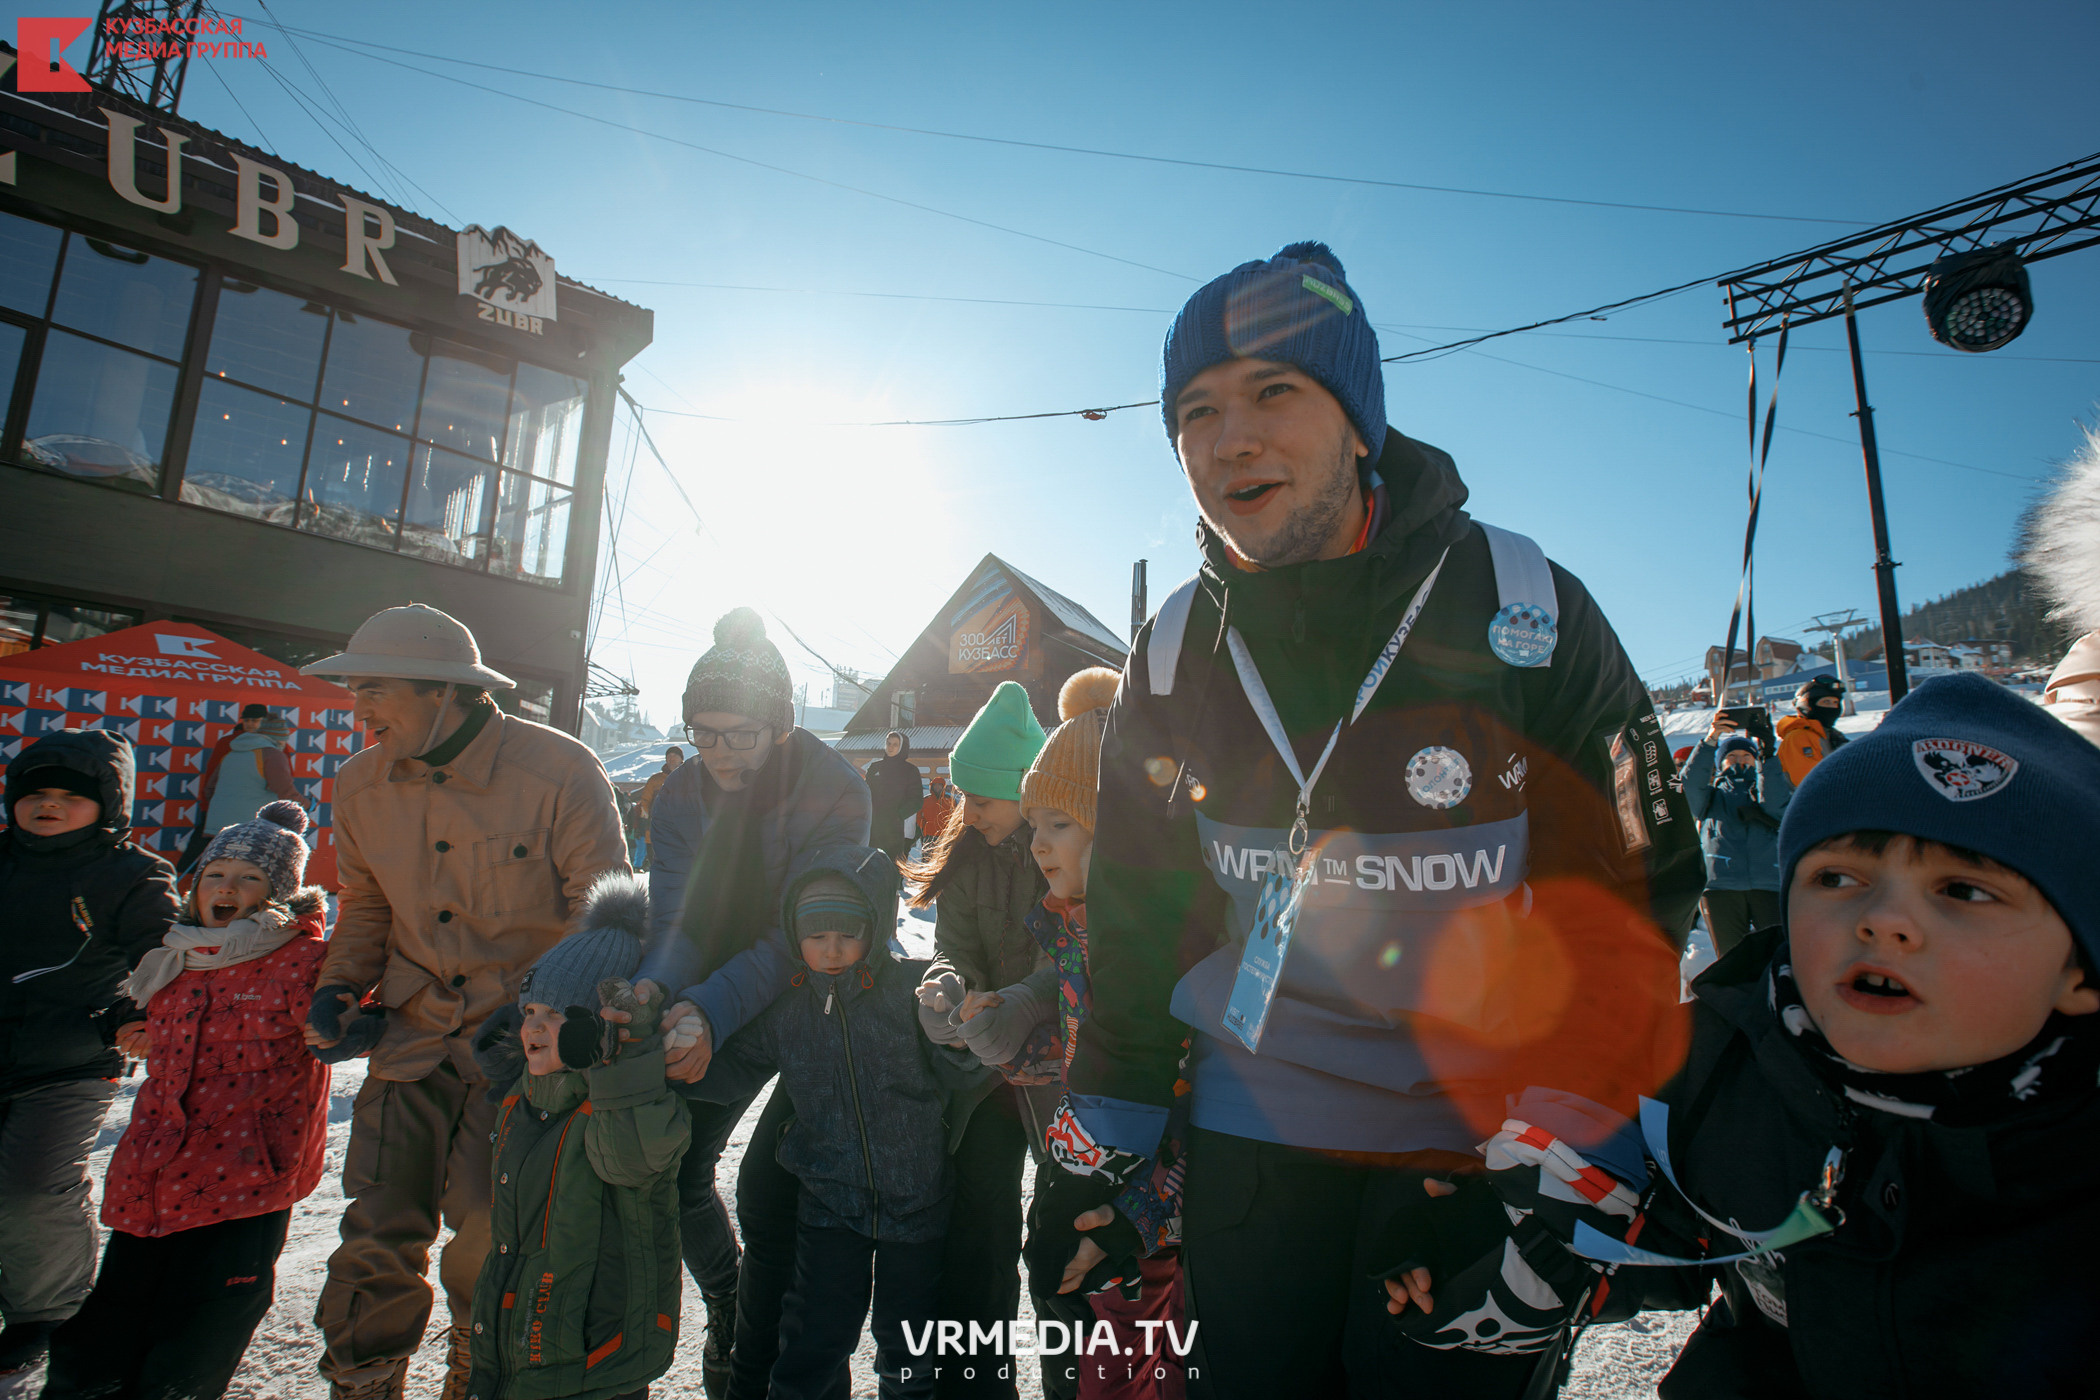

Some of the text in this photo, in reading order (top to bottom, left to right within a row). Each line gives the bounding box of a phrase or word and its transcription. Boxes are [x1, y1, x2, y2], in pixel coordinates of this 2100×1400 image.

[0, 53, 398, 287] UBR
[477, 302, 543, 336] ZUBR
[959, 633, 985, 647] 300
[959, 645, 1018, 661] КУЗБАСС
[1515, 641, 1546, 654] ГОРЕ
[81, 662, 302, 691] МЕДИА ГРУППА
[98, 653, 282, 679] КУЗБАССКАЯ
[1355, 845, 1506, 892] SNOW
